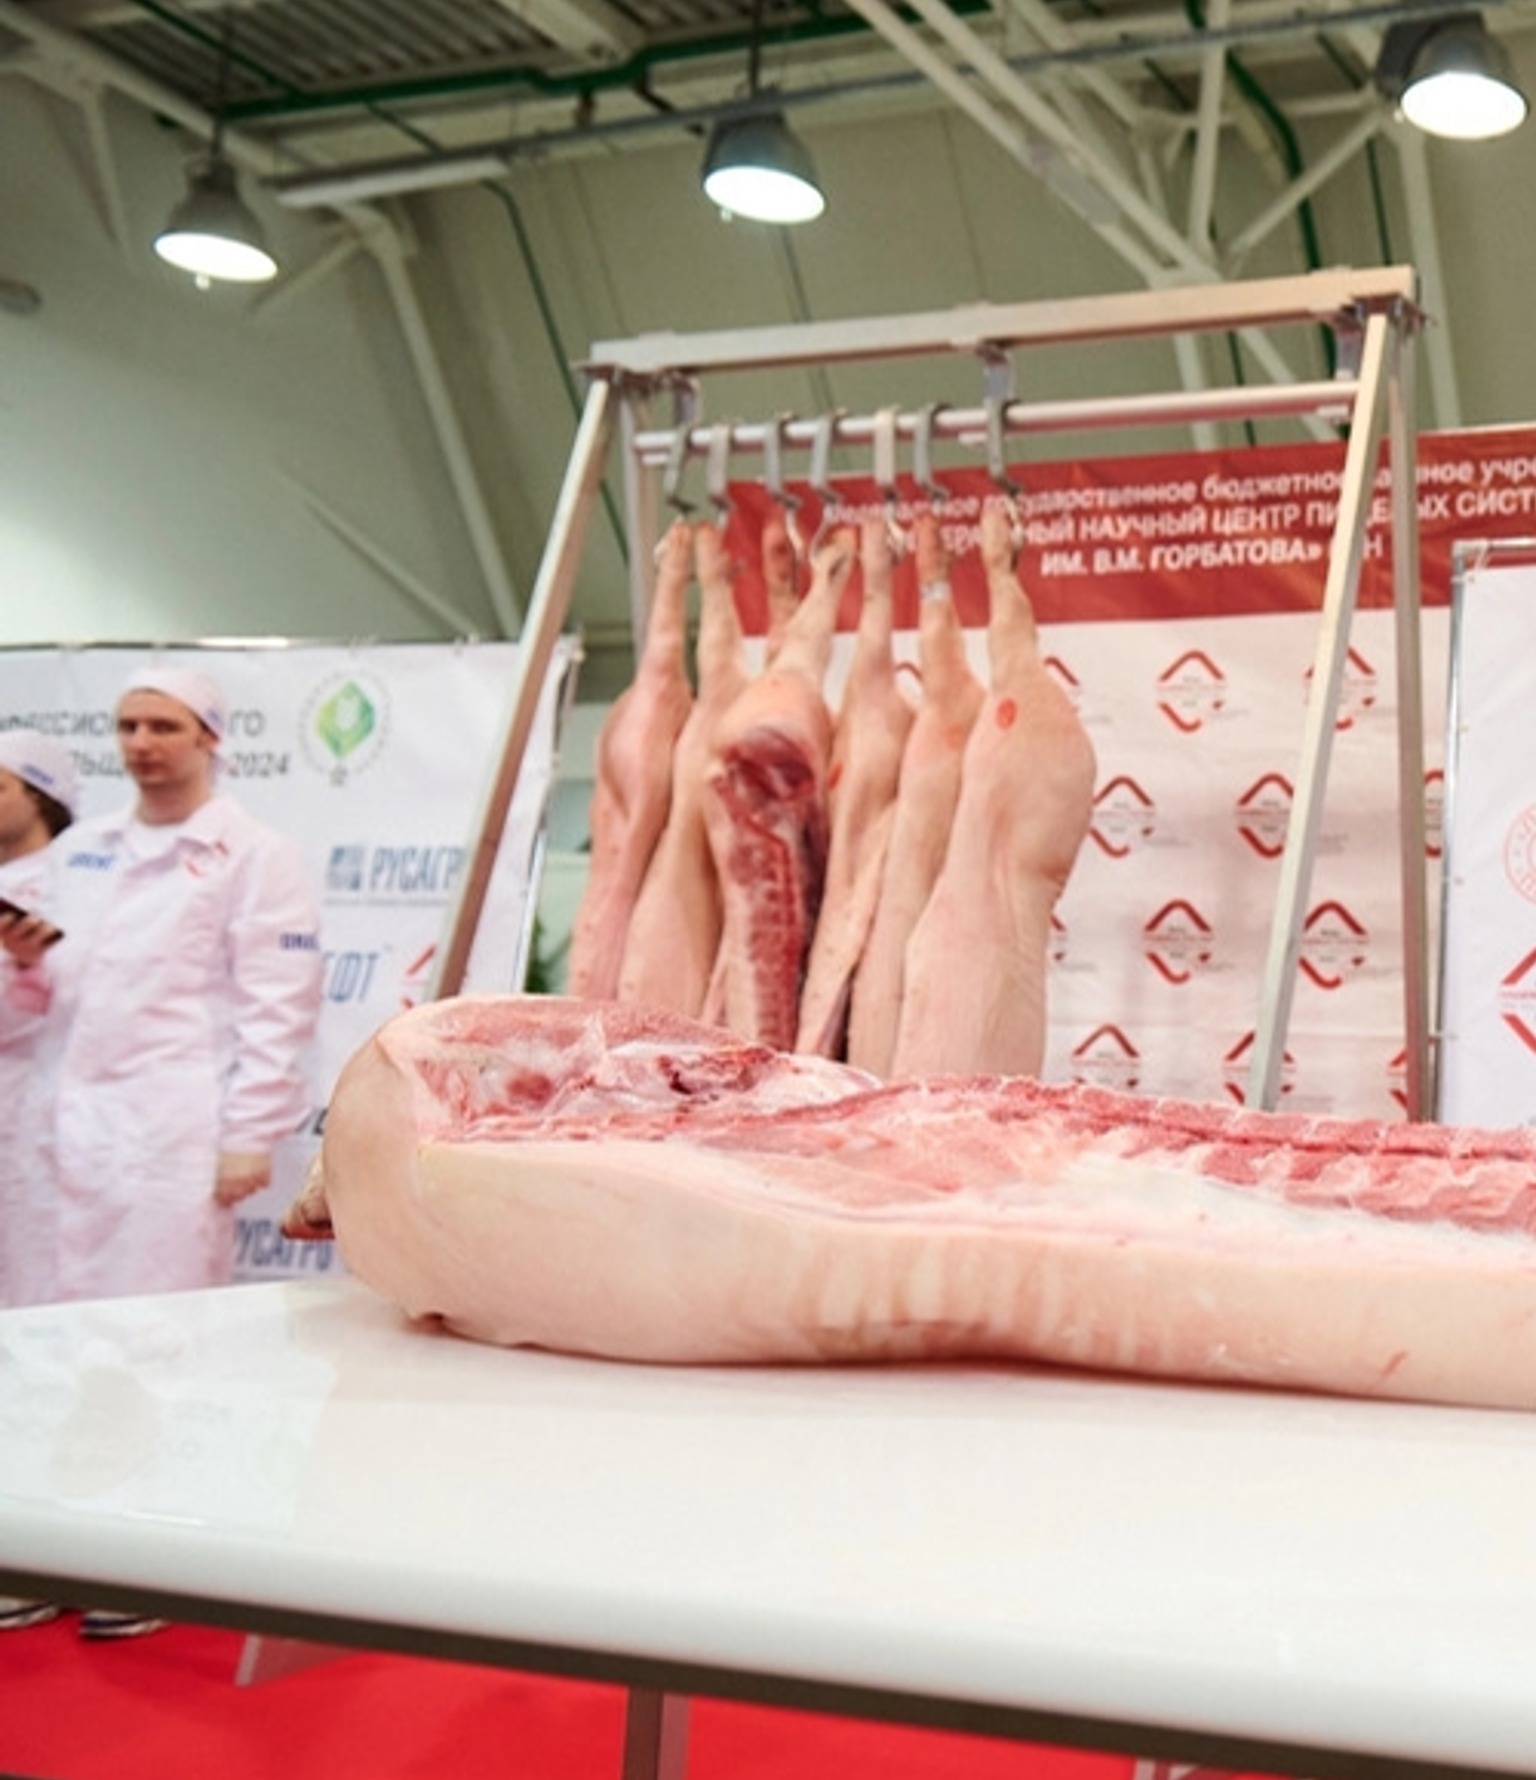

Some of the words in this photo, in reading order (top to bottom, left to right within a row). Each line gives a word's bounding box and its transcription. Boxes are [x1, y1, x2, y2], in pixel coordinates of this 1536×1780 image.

[1080, 505, 1207, 541] НАУЧНЫЙ
[1211, 504, 1301, 536] ЦЕНТР
[1305, 493, 1450, 529] ПИЕЫХ
[1040, 551, 1088, 577] ИМ.
[1149, 538, 1323, 571] ГОРБАТОВА»
